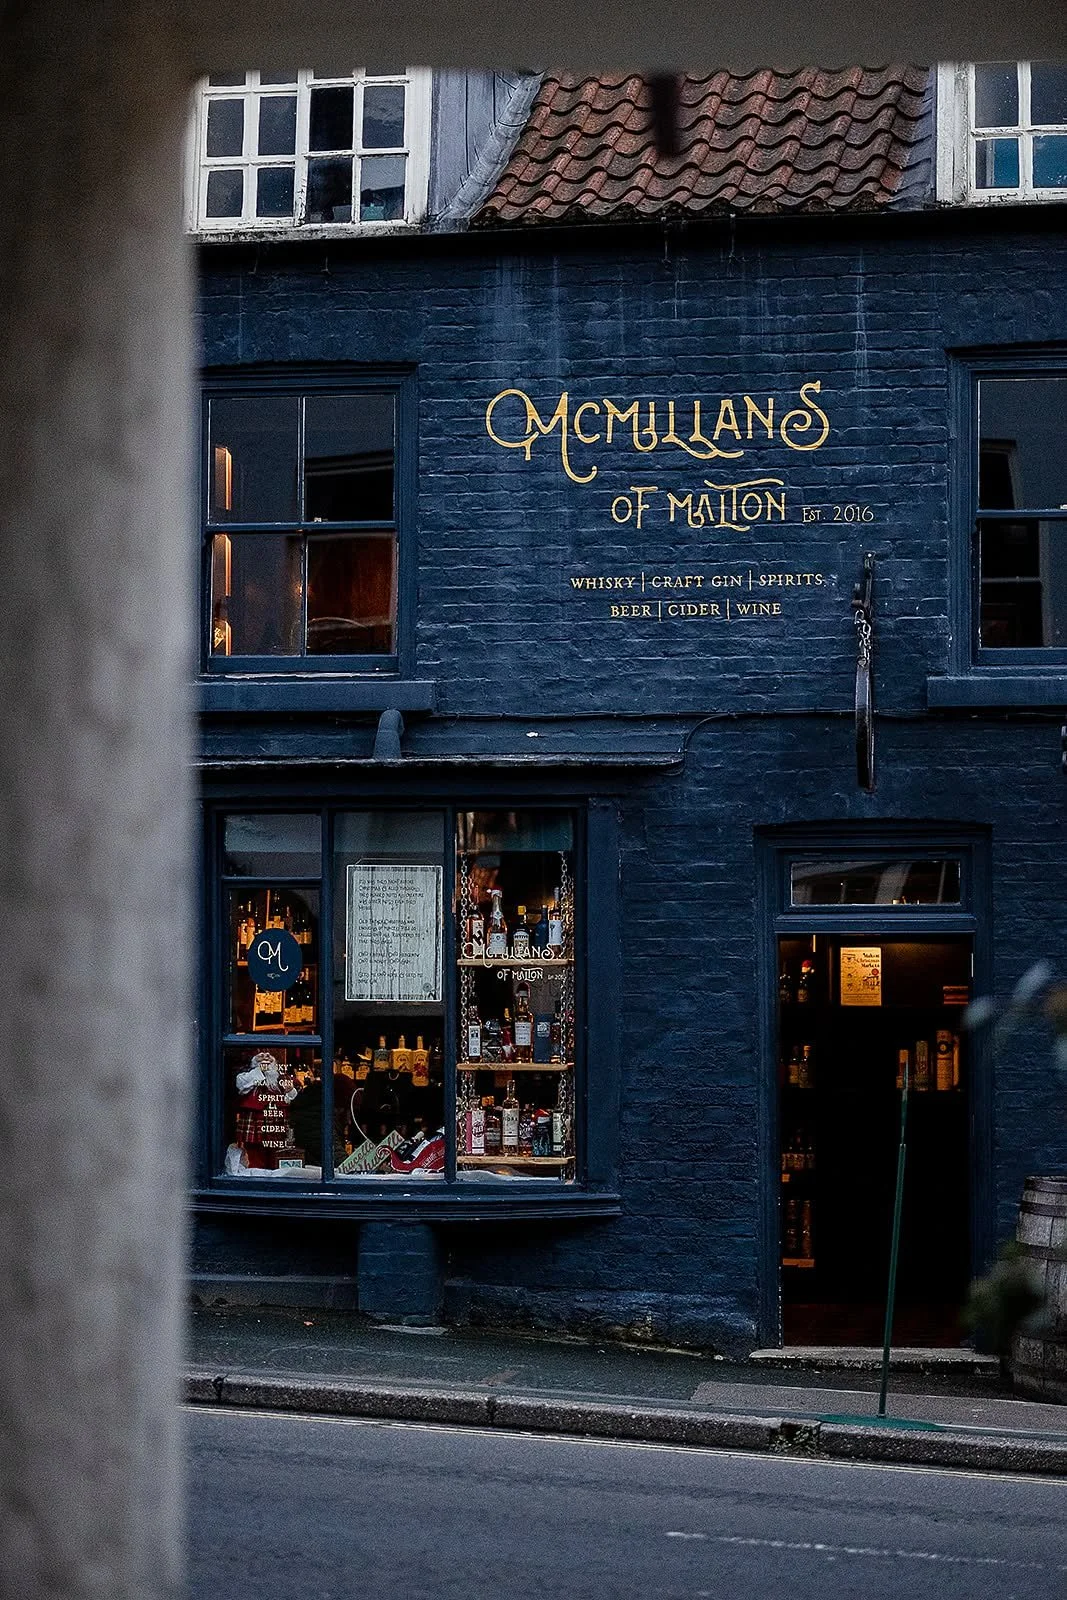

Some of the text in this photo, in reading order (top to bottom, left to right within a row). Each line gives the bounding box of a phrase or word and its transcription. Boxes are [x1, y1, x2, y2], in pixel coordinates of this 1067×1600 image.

[611, 478, 787, 532] OF MALTON
[832, 504, 874, 522] 2016
[570, 573, 823, 590] WHISKY CRAFT GIN SPIRITS
[610, 601, 782, 617] BEER CIDER WINE
[497, 968, 510, 981] OF
[512, 967, 544, 981] MALTON
[258, 1094, 289, 1102] SPIRIT
[263, 1109, 284, 1118] BEER
[260, 1125, 286, 1133] CIDER
